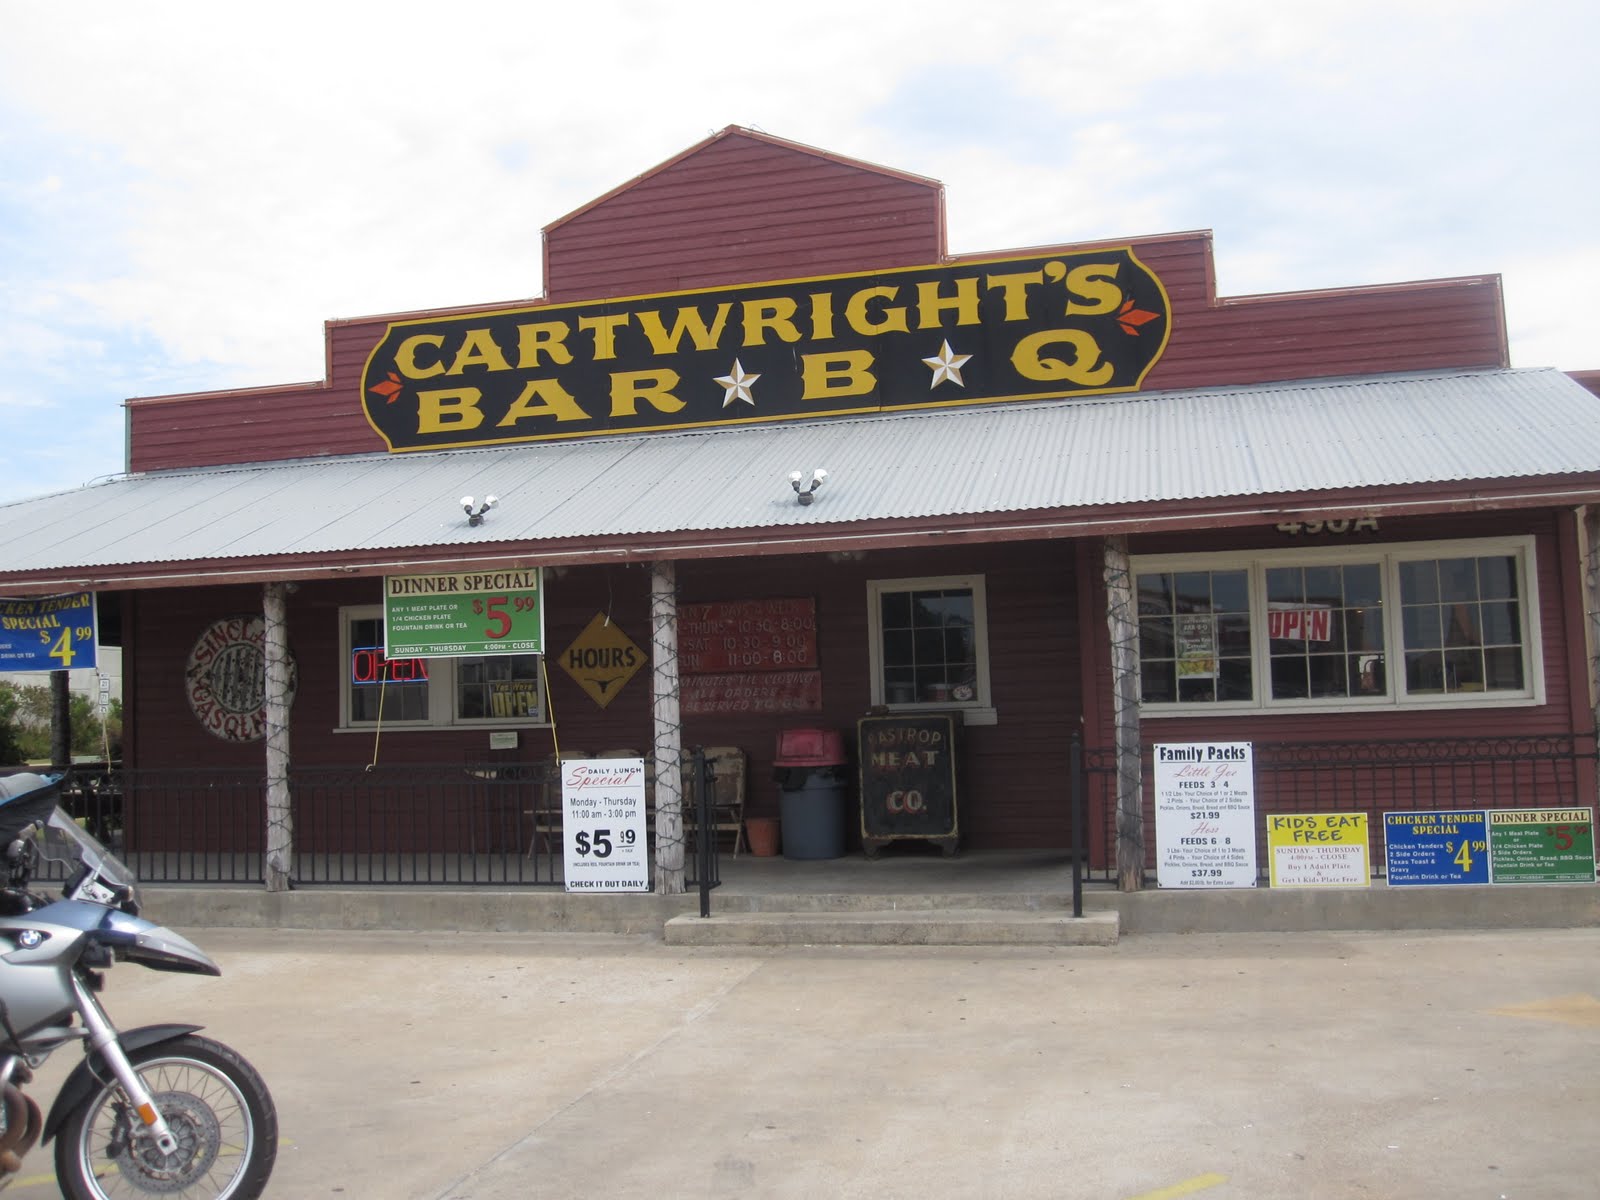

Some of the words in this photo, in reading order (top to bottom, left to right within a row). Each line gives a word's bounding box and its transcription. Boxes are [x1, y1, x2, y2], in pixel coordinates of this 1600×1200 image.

[394, 261, 1123, 379] CARTWRIGHT'S
[416, 368, 688, 434] BAR
[801, 349, 878, 400] B
[1010, 329, 1114, 387] Q
[391, 576, 459, 594] DINNER
[464, 572, 534, 591] SPECIAL
[39, 593, 90, 613] TENDER
[2, 614, 61, 630] SPECIAL
[433, 613, 451, 621] PLATE
[392, 624, 423, 632] FOUNTAIN
[1268, 608, 1328, 640] OPEN
[394, 646, 423, 654] SUNDAY
[429, 644, 467, 652] THURSDAY
[569, 646, 636, 669] HOURS
[870, 751, 939, 768] MEAT
[1160, 746, 1203, 763] Family
[1208, 746, 1246, 760] Packs
[1174, 764, 1211, 777] Little
[566, 766, 634, 791] Special
[570, 798, 597, 808] Monday
[603, 797, 637, 807] Thursday
[572, 810, 590, 818] 11:00
[608, 809, 623, 818] 3:00
[625, 810, 637, 819] pm
[1387, 815, 1436, 825] CHICKEN
[1439, 814, 1483, 824] TENDER
[1493, 813, 1537, 823] DINNER
[1540, 812, 1588, 822] SPECIAL
[1274, 817, 1317, 830] KIDS
[1326, 816, 1360, 828] EAT
[1412, 824, 1459, 835] SPECIAL
[1181, 837, 1207, 845] FEEDS
[1293, 830, 1343, 843] FREE
[1192, 869, 1222, 877] $37.99
[570, 880, 595, 888] CHECK
